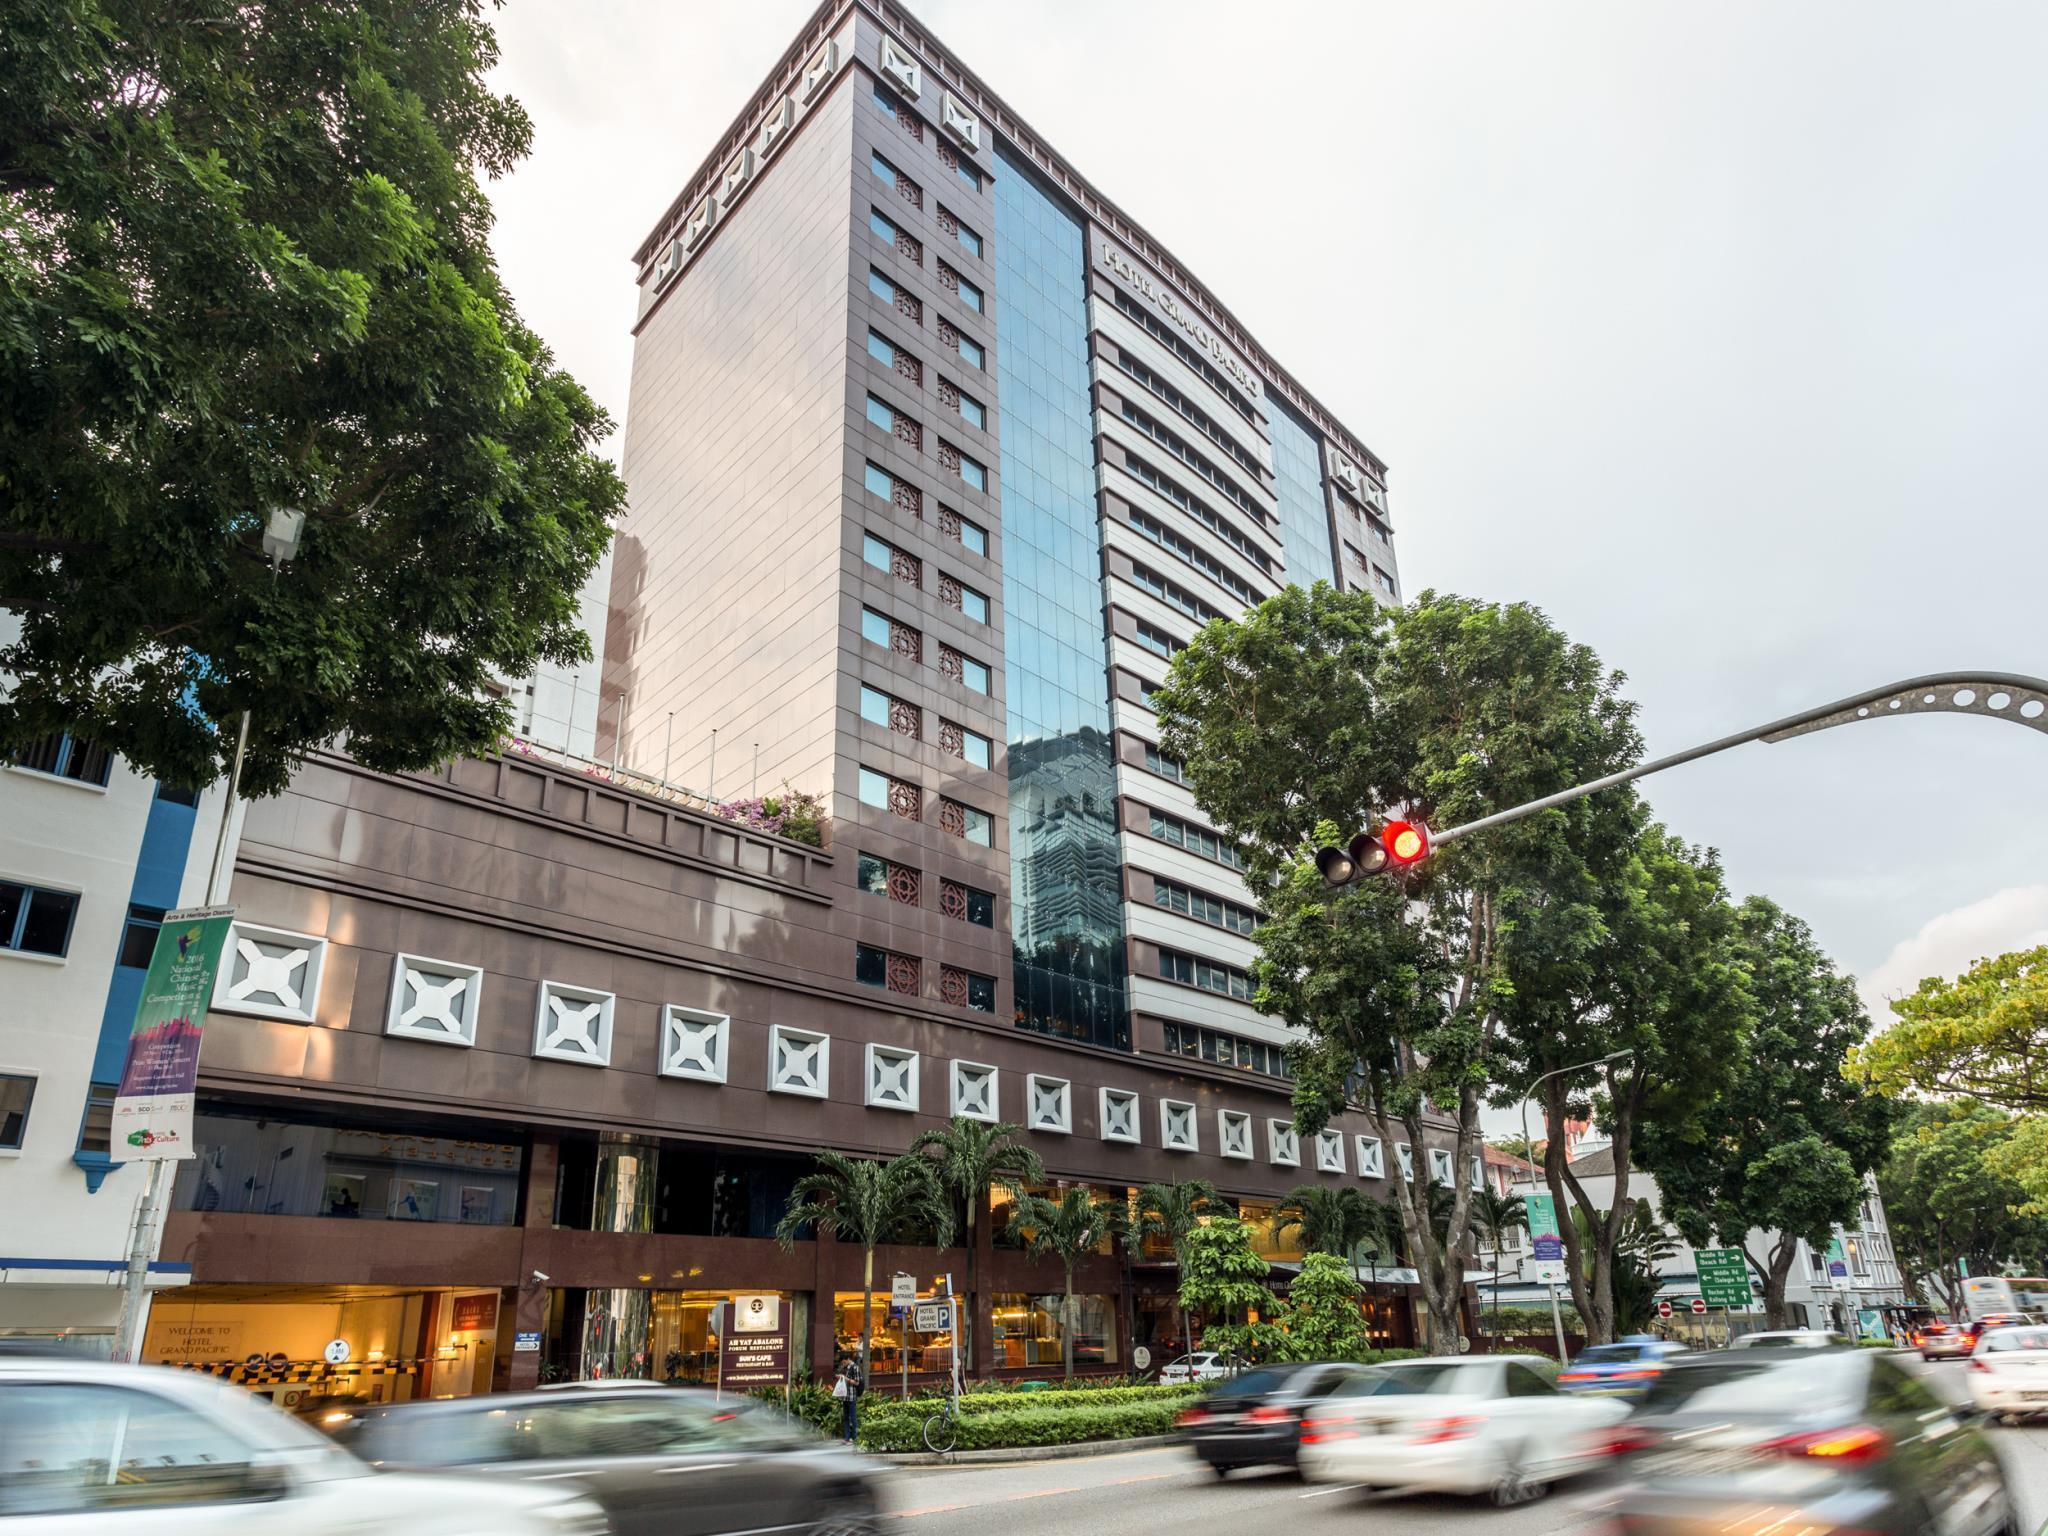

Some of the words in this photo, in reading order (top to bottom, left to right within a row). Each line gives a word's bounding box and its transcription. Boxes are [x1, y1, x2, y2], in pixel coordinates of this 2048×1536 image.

[1102, 243, 1156, 303] HOTEL
[1157, 292, 1208, 349] GRAND
[170, 963, 202, 974] National
[147, 991, 194, 1004] Competition
[938, 1309, 948, 1326] P
[160, 1346, 194, 1355] GRAND
[194, 1345, 230, 1354] PACIFIC
